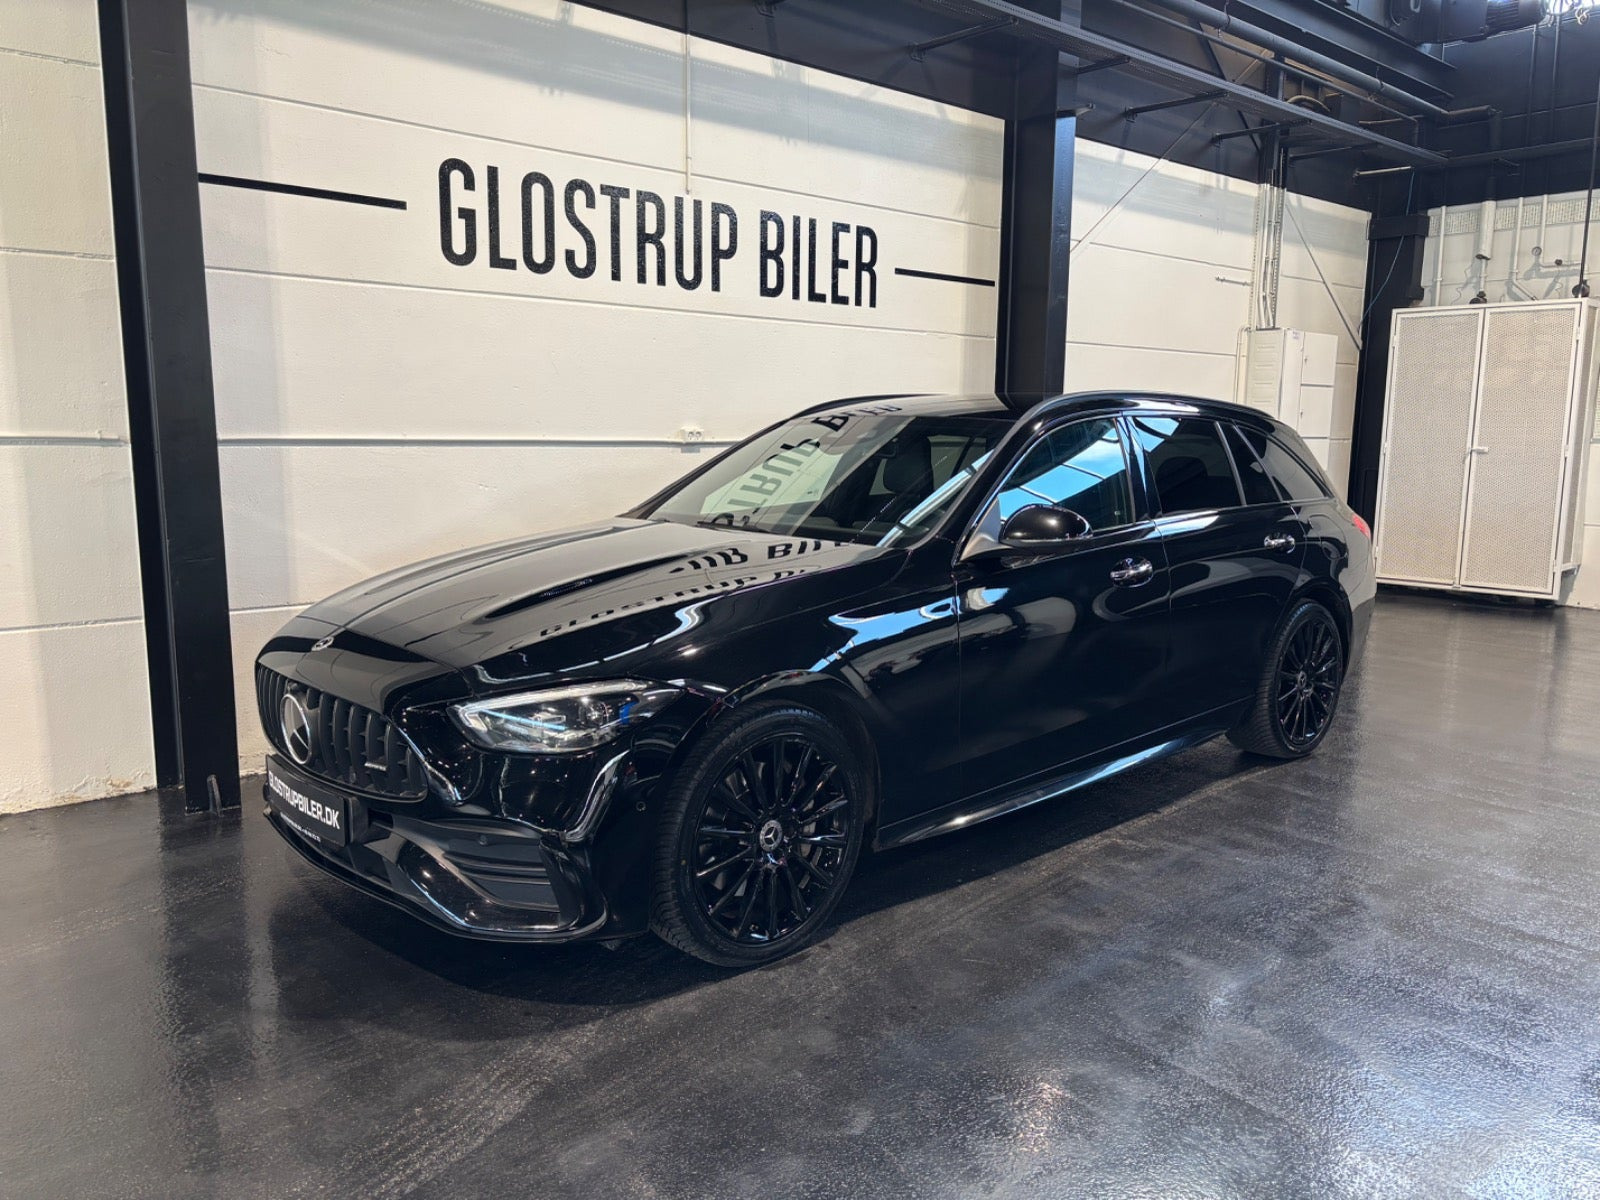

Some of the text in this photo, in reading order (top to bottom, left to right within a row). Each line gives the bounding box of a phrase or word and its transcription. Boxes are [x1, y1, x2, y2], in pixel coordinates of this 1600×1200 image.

[438, 158, 877, 308] GLOSTRUP BILER
[268, 770, 340, 829] GLOSTRUPBILER.DK
